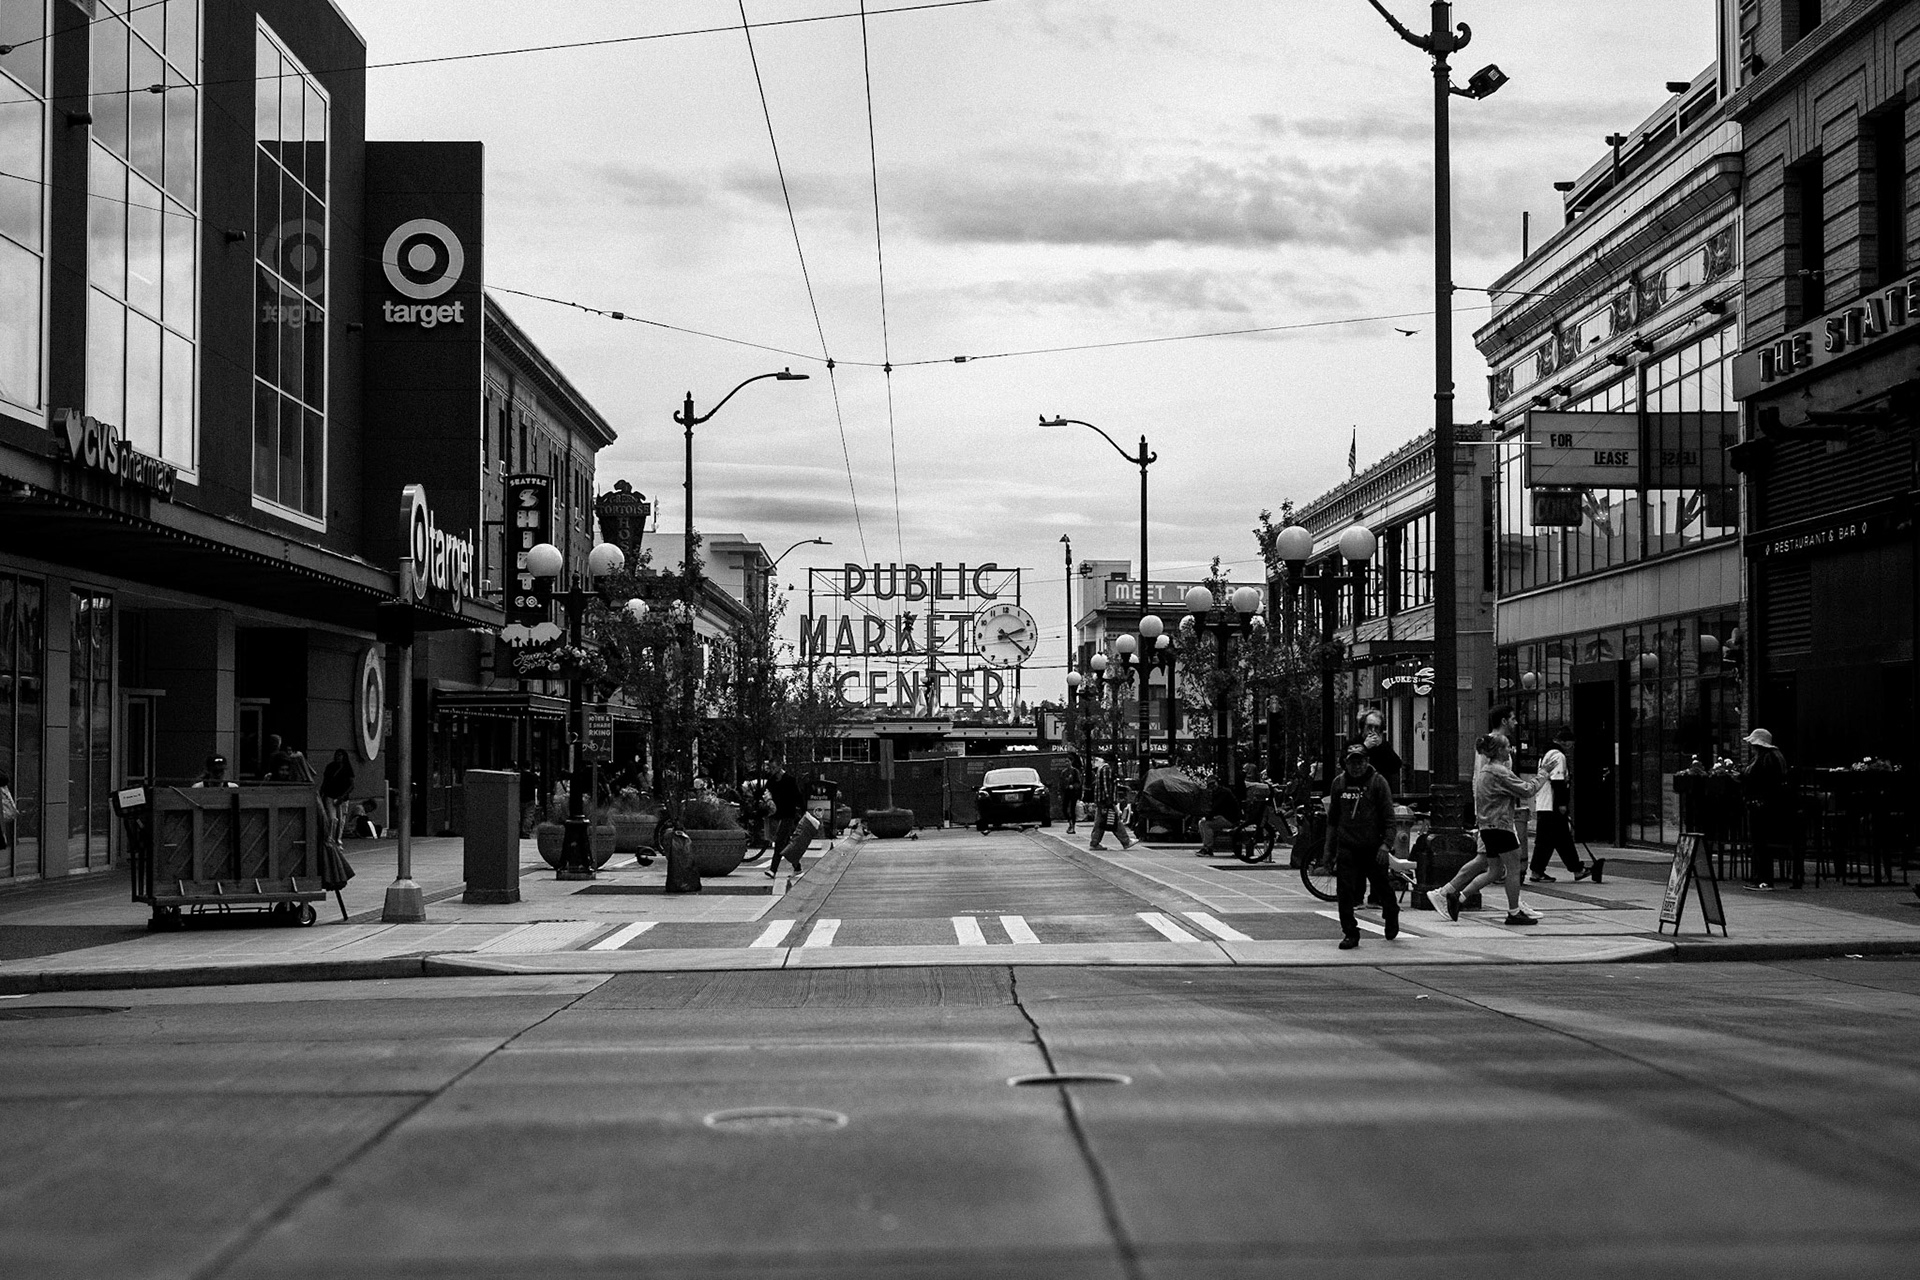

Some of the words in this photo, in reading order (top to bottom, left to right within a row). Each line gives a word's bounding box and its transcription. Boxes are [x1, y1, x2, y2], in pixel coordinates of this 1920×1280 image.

[383, 300, 464, 328] target
[1758, 332, 1813, 382] THE
[1824, 277, 1920, 353] STATE
[1550, 433, 1573, 448] FOR
[84, 416, 119, 475] CVS
[119, 447, 177, 504] pharmacy
[1594, 451, 1629, 465] LEASE
[509, 477, 548, 487] SEATTLE
[598, 504, 650, 515] TORTOISE
[609, 493, 639, 504] GREEN
[1773, 531, 1826, 554] RESTAURANT
[1828, 529, 1836, 542] &
[1838, 524, 1857, 540] BAR
[429, 509, 474, 614] target
[844, 562, 998, 601] PUBLIC
[1115, 583, 1166, 600] MEET
[514, 595, 542, 608] CO.
[800, 614, 974, 657] MARKET
[836, 670, 1006, 709] CENTER
[1389, 675, 1419, 685] LUKE'S
